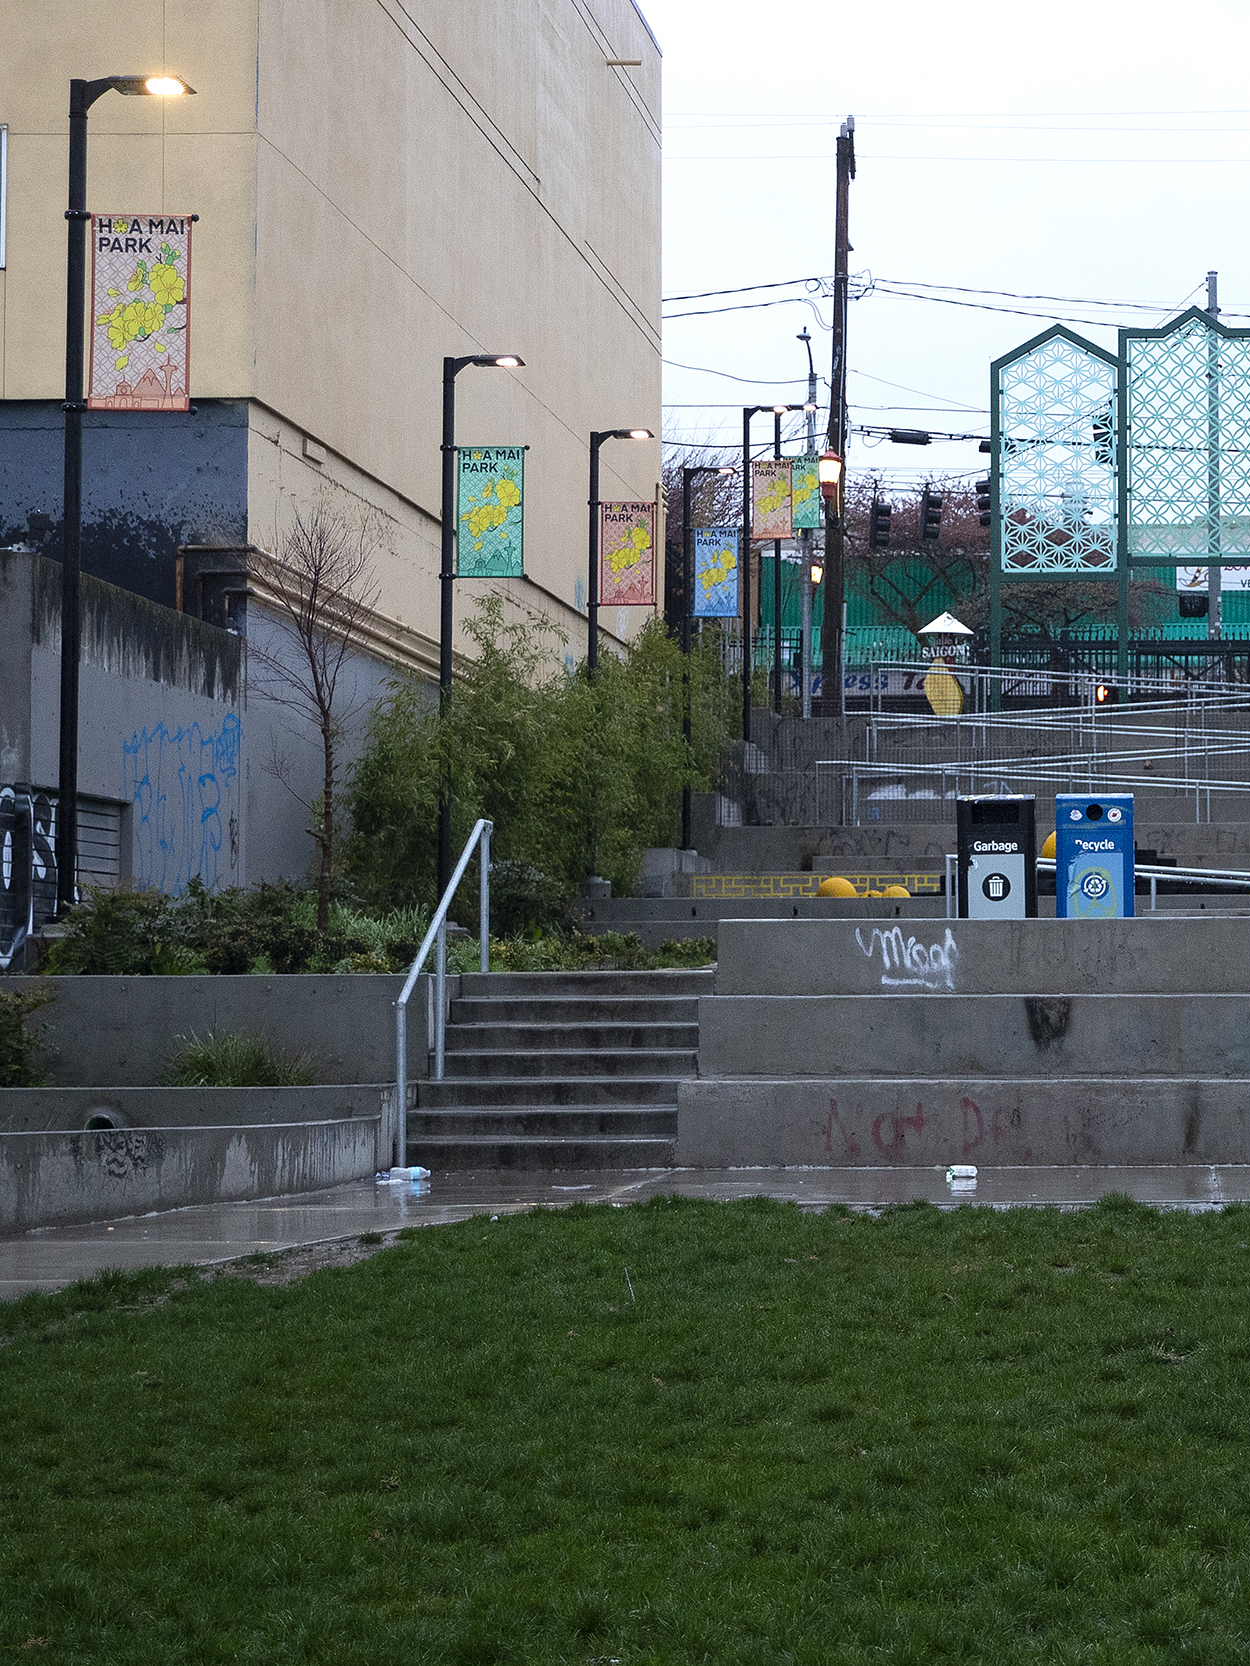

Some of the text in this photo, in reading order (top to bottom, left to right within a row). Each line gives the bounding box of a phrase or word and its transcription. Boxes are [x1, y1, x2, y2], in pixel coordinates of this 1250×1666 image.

[149, 218, 184, 235] MAI
[99, 237, 152, 253] PARK
[496, 450, 520, 460] MAI
[462, 462, 498, 473] PARK
[631, 504, 650, 513] MAI
[605, 514, 633, 522] PARK
[719, 530, 736, 538] MAI
[922, 645, 966, 658] SAIGON
[973, 840, 1018, 853] Garbage
